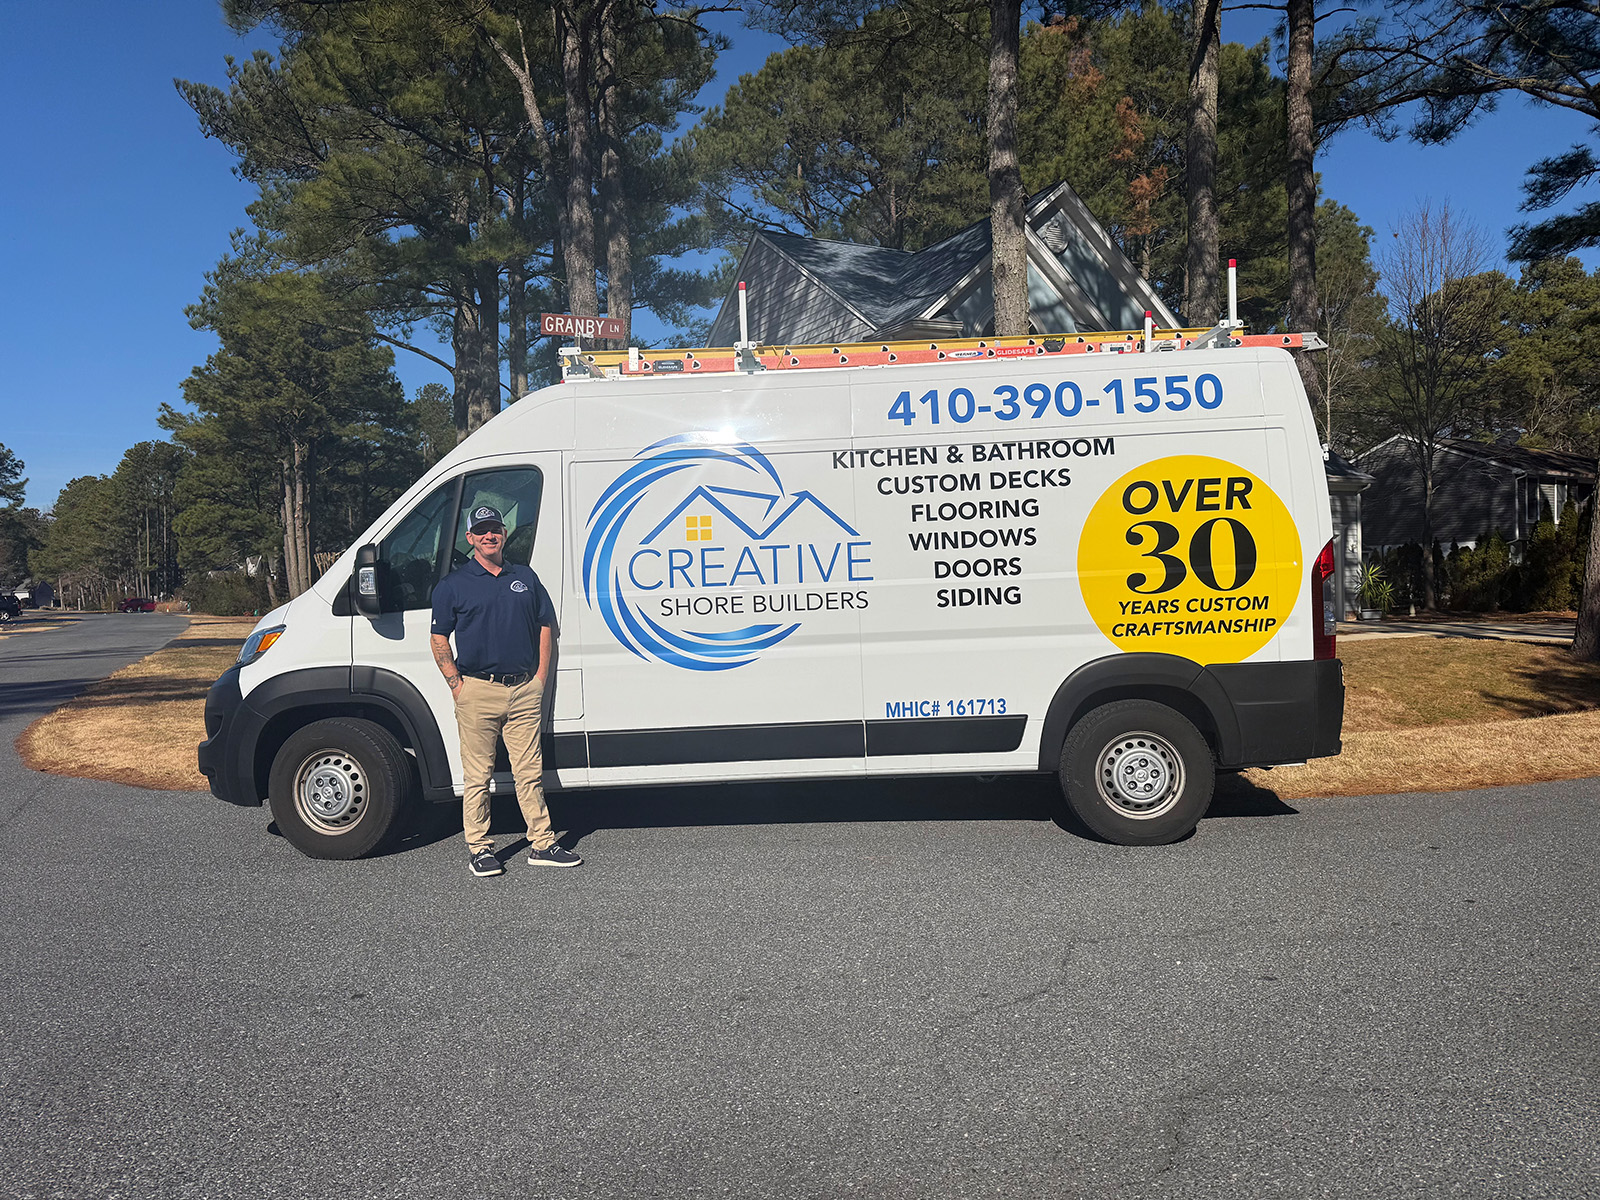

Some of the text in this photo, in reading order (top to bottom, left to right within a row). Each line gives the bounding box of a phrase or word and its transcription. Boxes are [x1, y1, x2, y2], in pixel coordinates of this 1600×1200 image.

[545, 316, 620, 335] GRANBY LN
[997, 347, 1034, 356] GLIDESAFE
[887, 373, 1223, 426] 410-390-1550
[832, 437, 1116, 469] KITCHEN & BATHROOM
[877, 468, 1072, 495] CUSTOM DECKS
[1122, 477, 1253, 515] OVER
[910, 498, 1040, 522] FLOORING
[908, 527, 1037, 551] WINDOWS
[628, 541, 874, 590] CREATIVE
[934, 557, 1022, 579] DOORS
[1125, 517, 1257, 595] 30
[660, 590, 869, 617] SHORE BUILDERS
[936, 586, 1022, 608] SIDING
[1118, 595, 1270, 615] YEARS CUSTOM
[1111, 617, 1277, 637] CRAFTSMANSHIP
[886, 698, 1007, 718] MHIC# 161713
